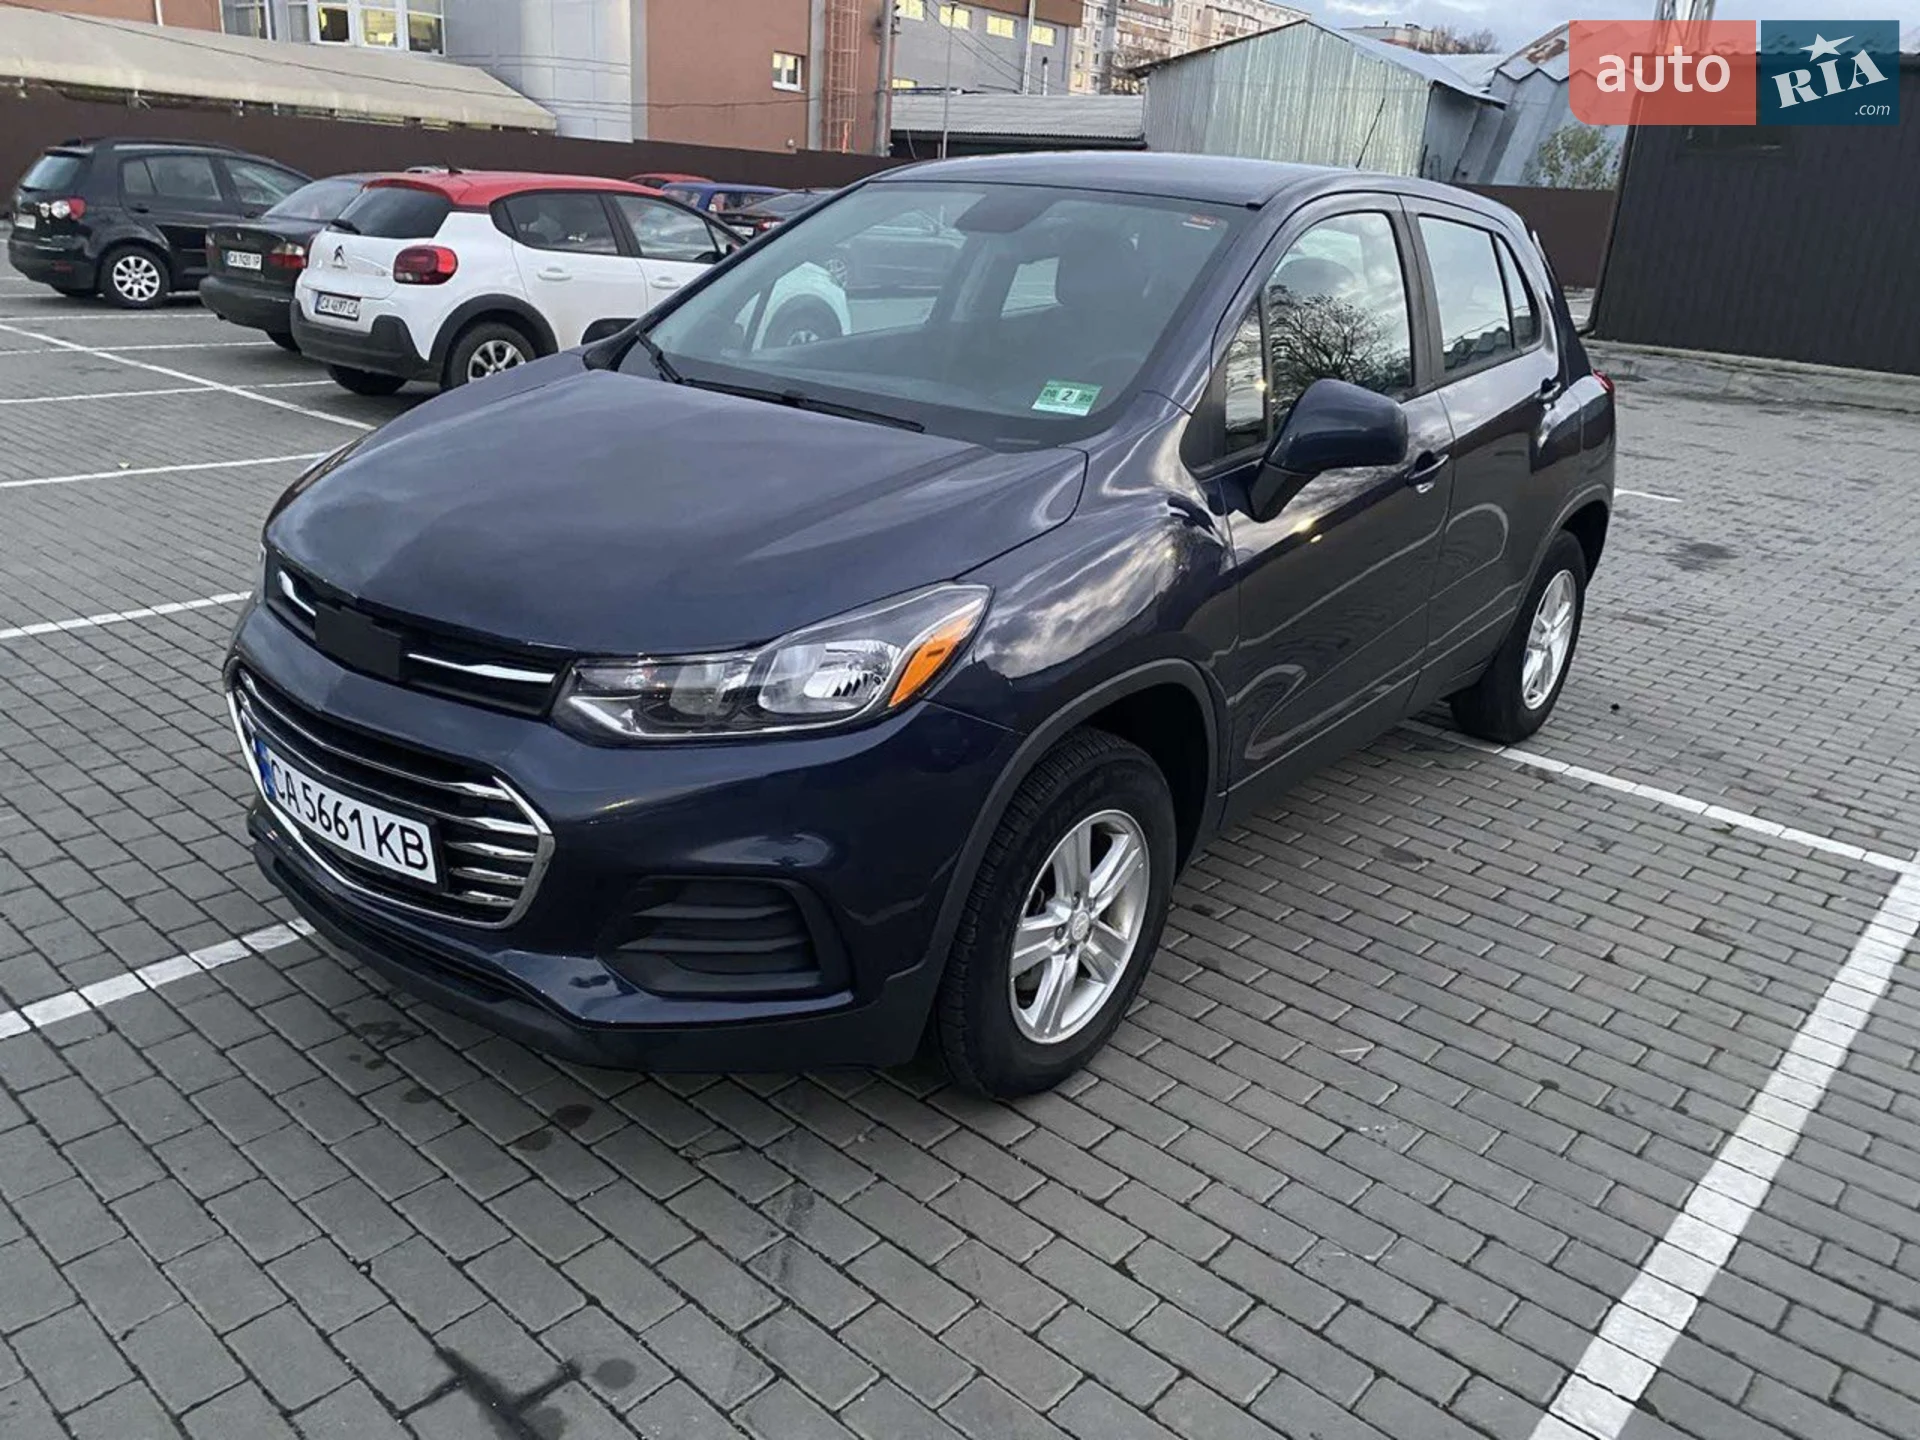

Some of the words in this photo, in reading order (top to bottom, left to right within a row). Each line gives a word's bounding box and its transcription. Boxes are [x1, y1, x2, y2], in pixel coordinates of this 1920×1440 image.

[320, 296, 330, 310] CA
[1061, 390, 1073, 401] 2
[270, 759, 301, 814] CA
[301, 781, 366, 851] 5661
[373, 815, 429, 871] KB
